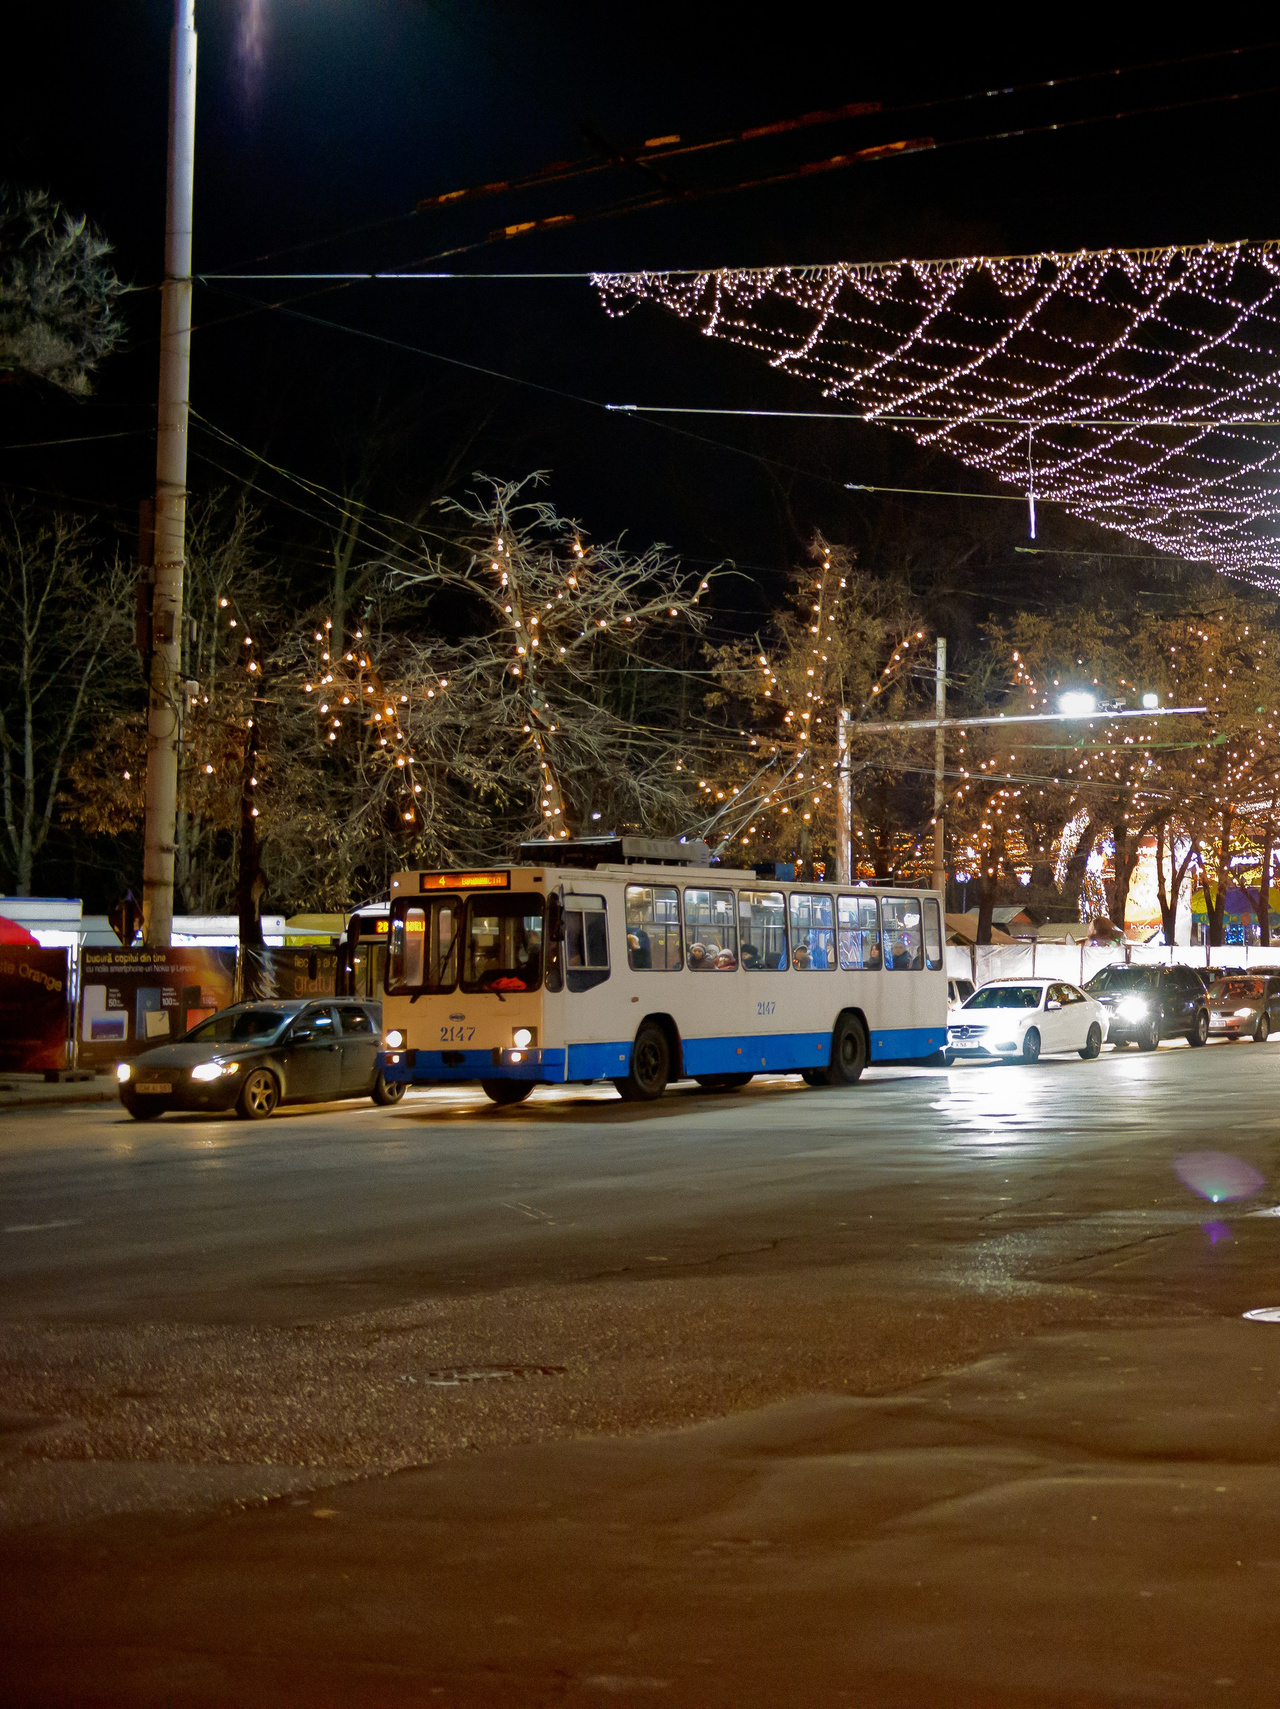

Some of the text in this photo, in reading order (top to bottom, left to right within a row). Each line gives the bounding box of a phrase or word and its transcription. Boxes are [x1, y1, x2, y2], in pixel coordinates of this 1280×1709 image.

[438, 875, 447, 886] 4
[19, 963, 63, 992] Orange
[294, 972, 336, 999] gratui
[757, 1001, 776, 1016] 2147
[440, 1026, 476, 1042] 2147
